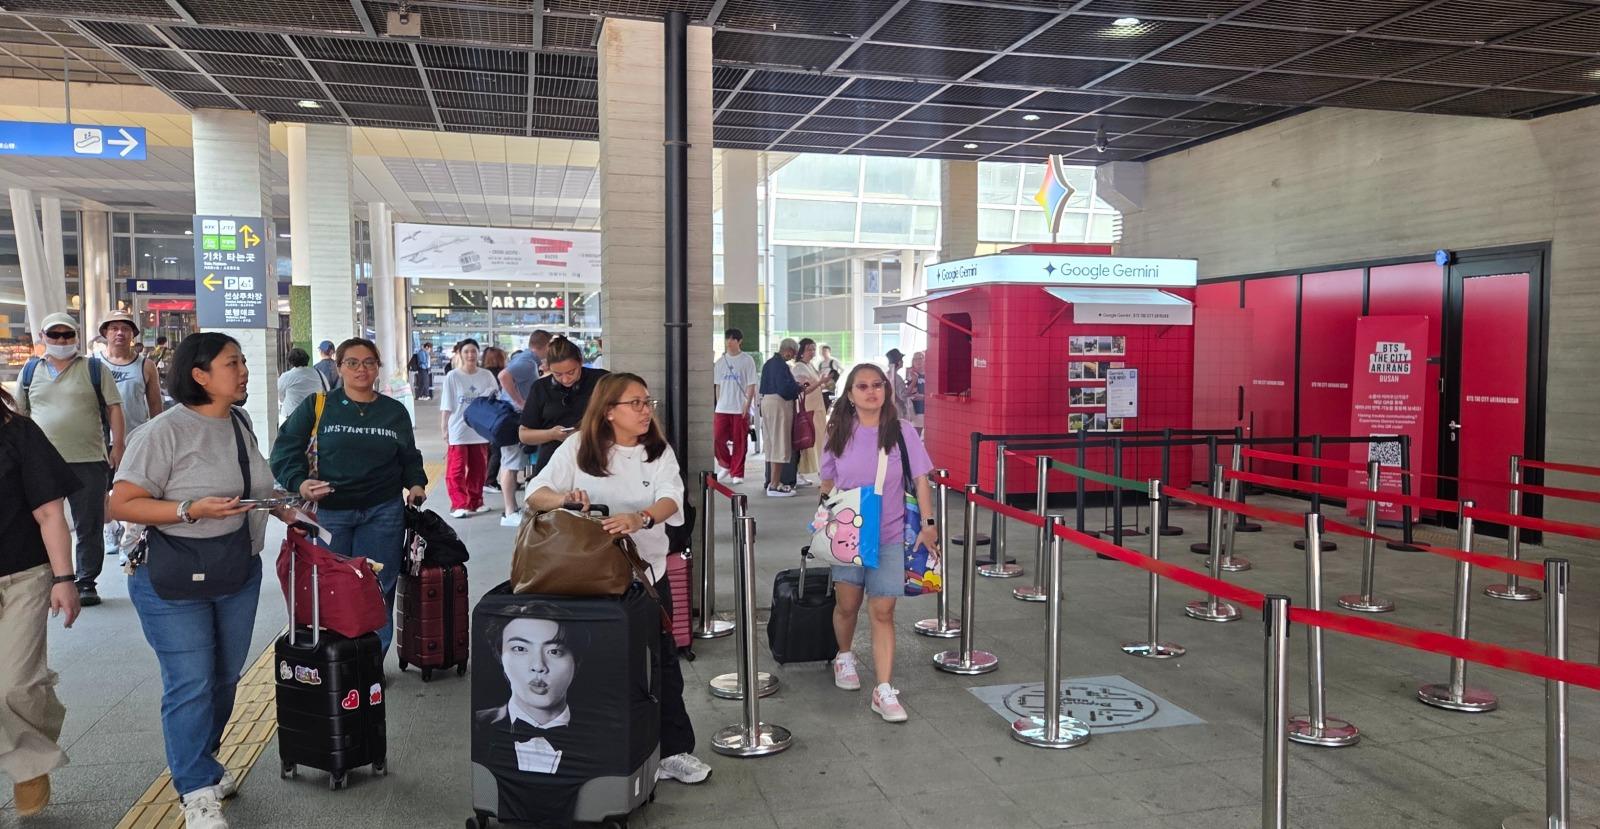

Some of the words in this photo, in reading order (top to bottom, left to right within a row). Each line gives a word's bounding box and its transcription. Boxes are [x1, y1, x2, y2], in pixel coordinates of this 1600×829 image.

[203, 252, 222, 261] 기차
[226, 252, 256, 262] 타는곳
[941, 267, 959, 283] Google
[960, 264, 978, 278] Gemini
[1060, 263, 1110, 280] Google
[1113, 263, 1159, 278] Gemini
[227, 279, 236, 287] P
[224, 292, 263, 300] 선상주차장
[1383, 344, 1399, 352] BTS
[1374, 353, 1388, 362] THE
[1390, 353, 1408, 363] CITY
[1371, 363, 1409, 372] ARIRANG
[1379, 374, 1399, 382] BUSAN
